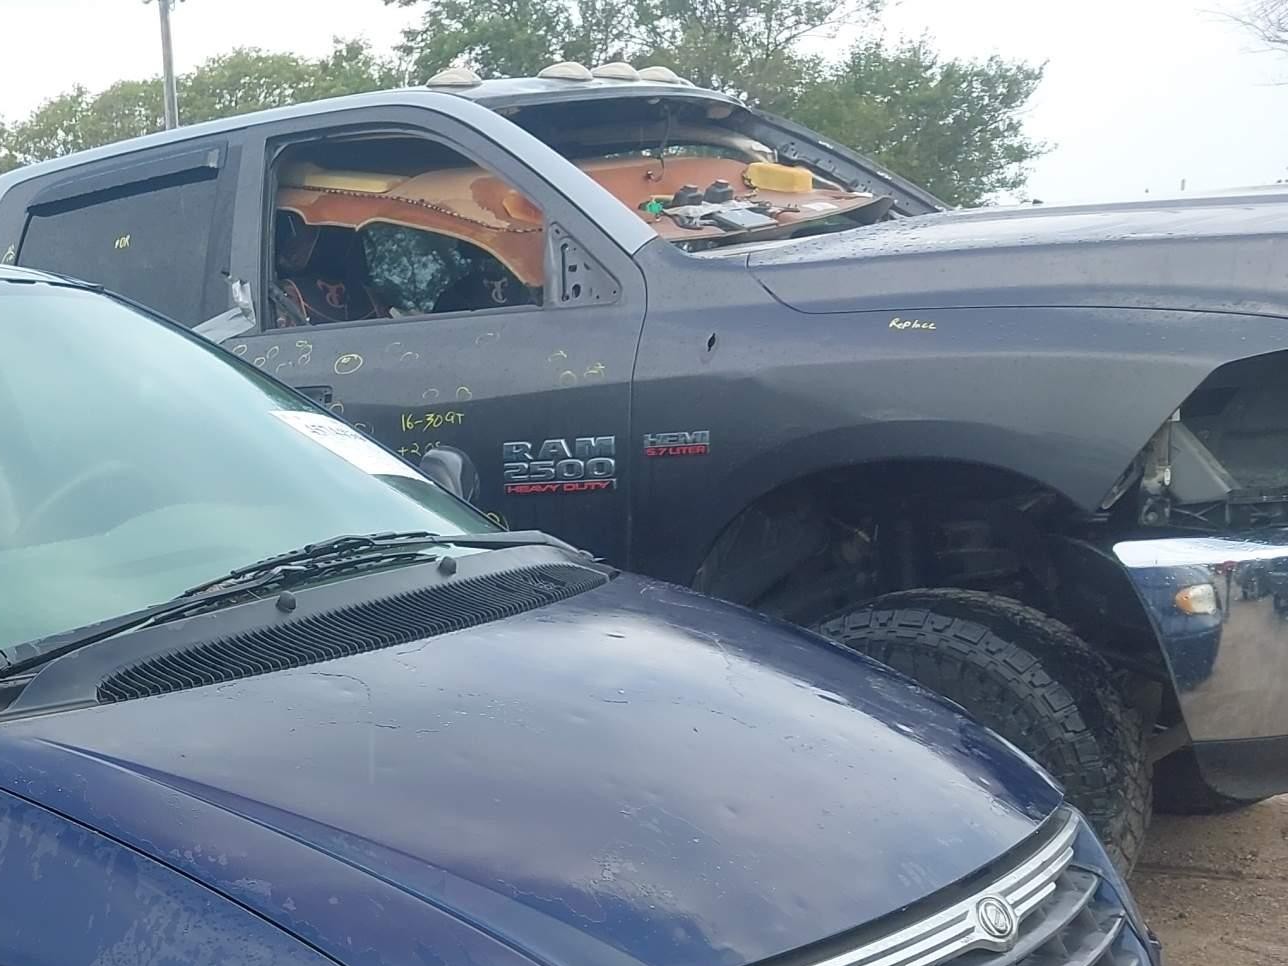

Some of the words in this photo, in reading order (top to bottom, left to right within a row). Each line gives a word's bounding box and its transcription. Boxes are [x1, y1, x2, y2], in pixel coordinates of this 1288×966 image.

[643, 431, 710, 447] HEMI
[503, 436, 615, 460] RAM
[669, 445, 706, 455] LITER
[503, 457, 615, 480] 2500
[507, 484, 561, 494] HEAVY
[563, 481, 610, 491] DUTY
